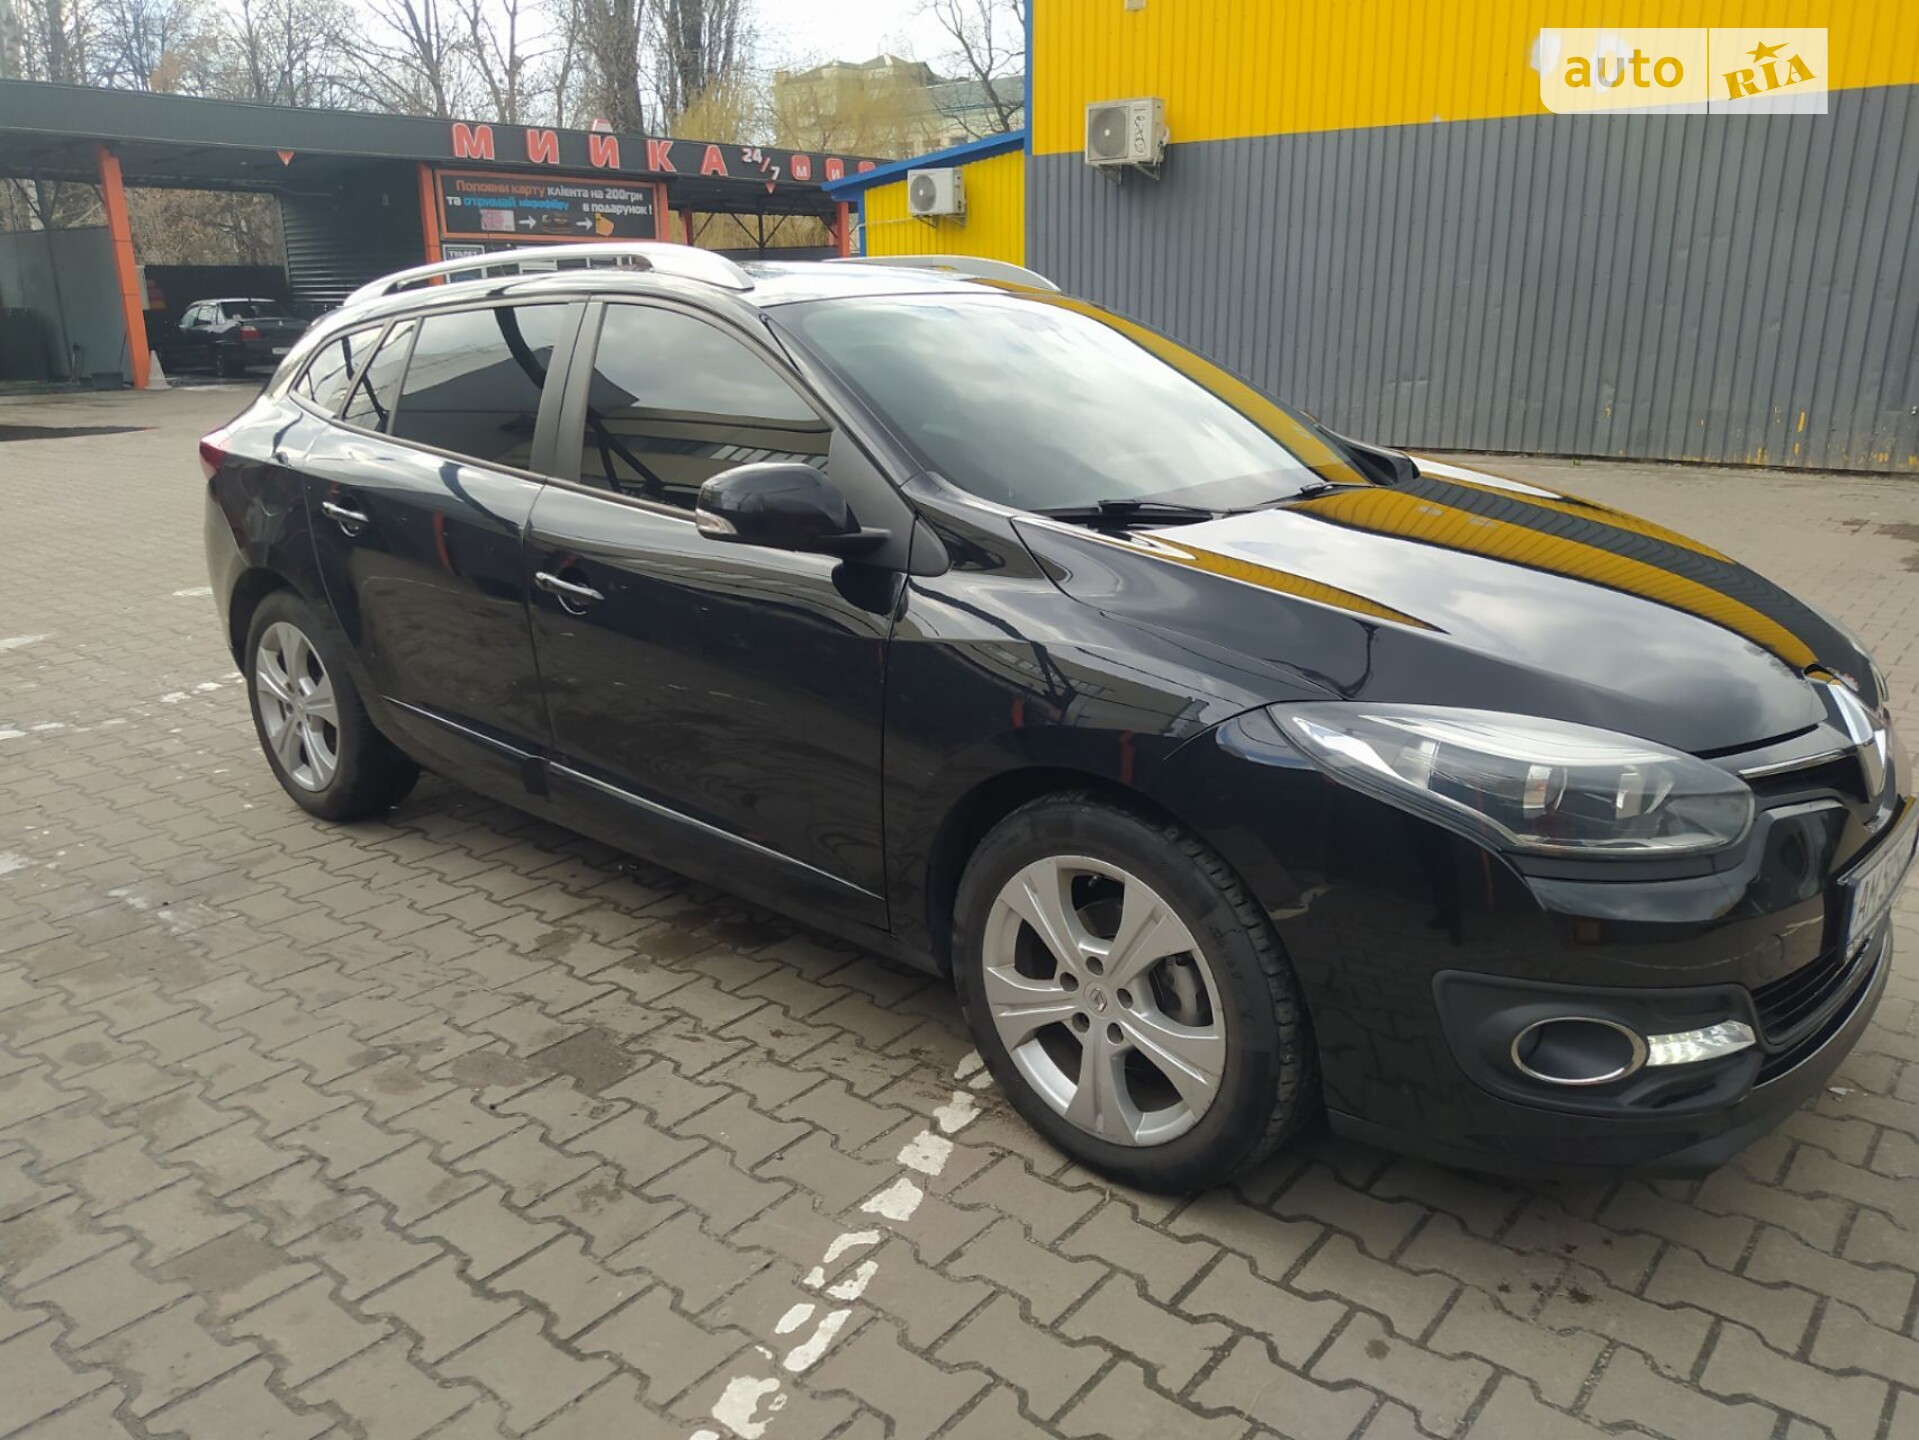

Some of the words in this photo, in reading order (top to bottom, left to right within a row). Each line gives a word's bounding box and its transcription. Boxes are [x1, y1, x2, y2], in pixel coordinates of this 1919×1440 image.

[451, 118, 728, 176] МИЙКА
[741, 147, 780, 181] 24/7
[590, 190, 604, 199] на
[446, 196, 461, 206] та
